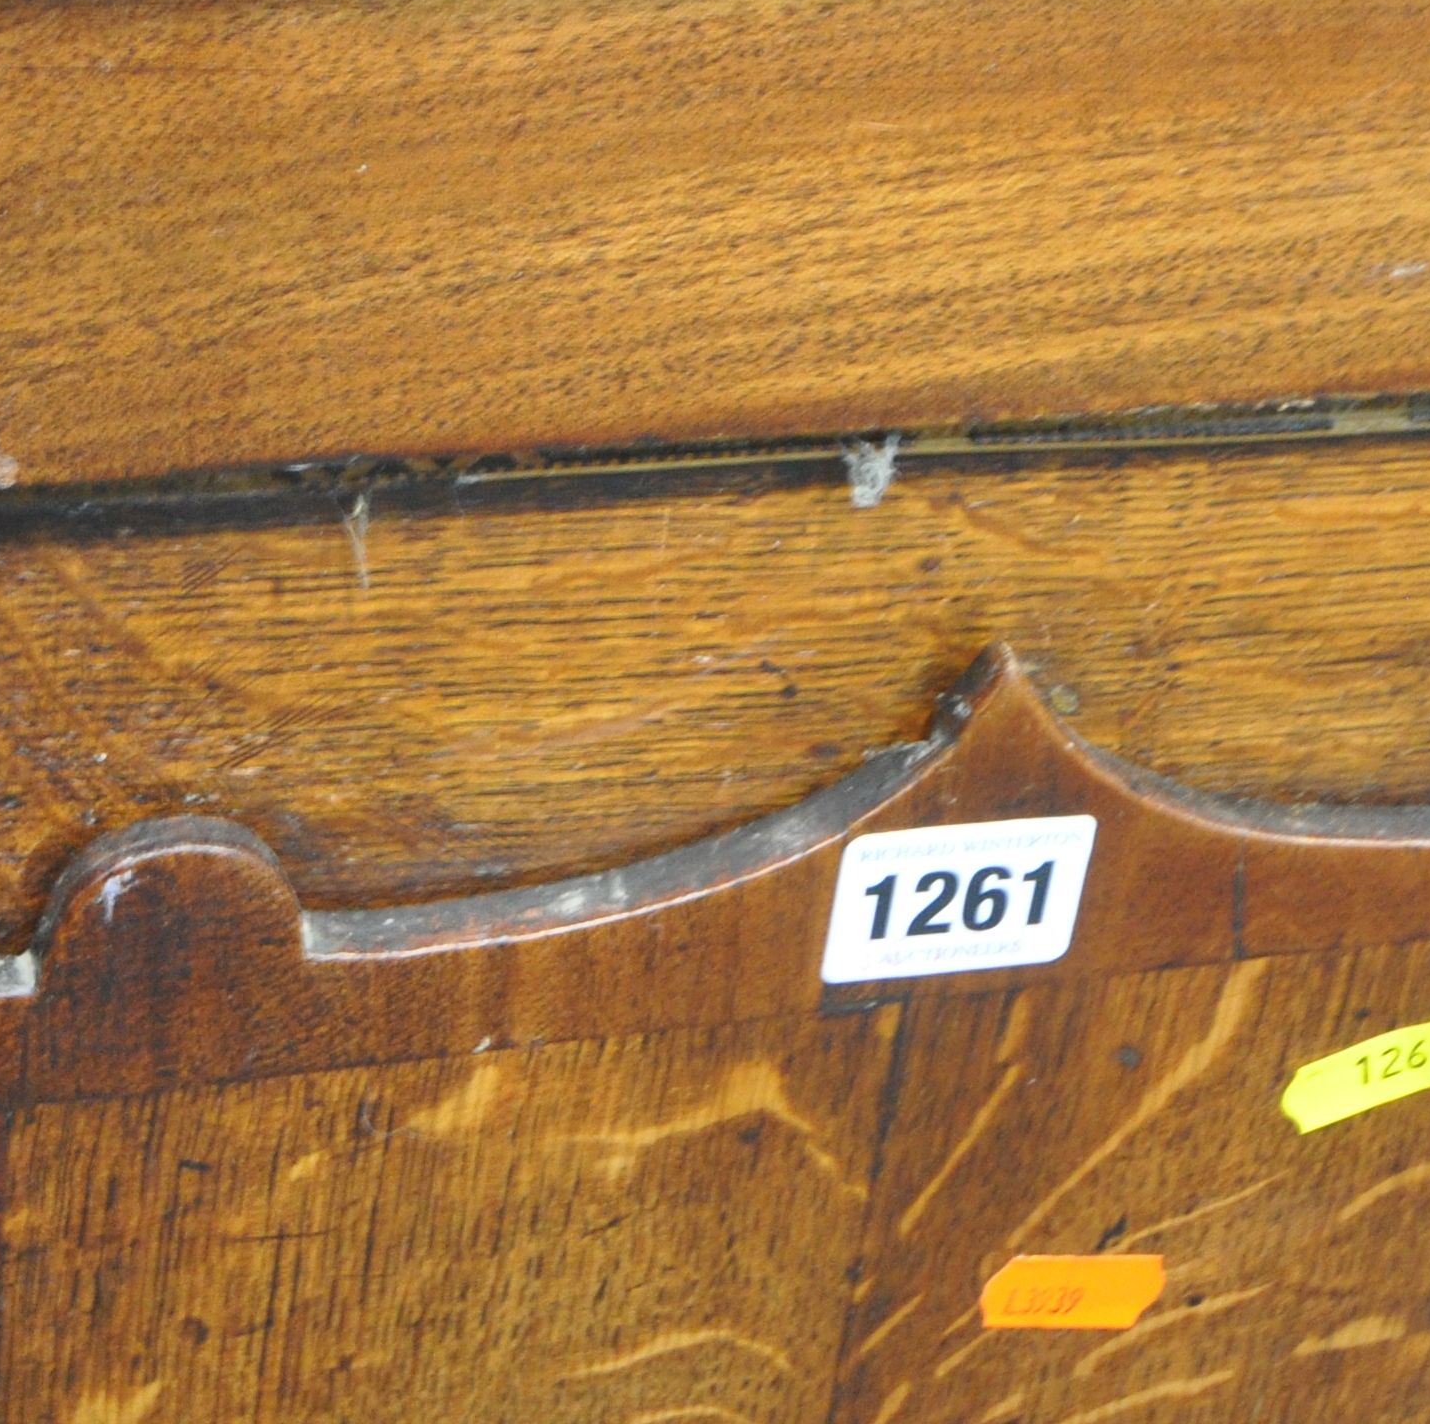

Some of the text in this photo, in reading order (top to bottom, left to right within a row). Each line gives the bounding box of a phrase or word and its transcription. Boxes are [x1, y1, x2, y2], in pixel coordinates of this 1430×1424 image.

[859, 831, 1084, 863] RICHARD WINTERTON
[864, 859, 1057, 941] 1261
[877, 939, 1023, 966] AUCTIONEERS
